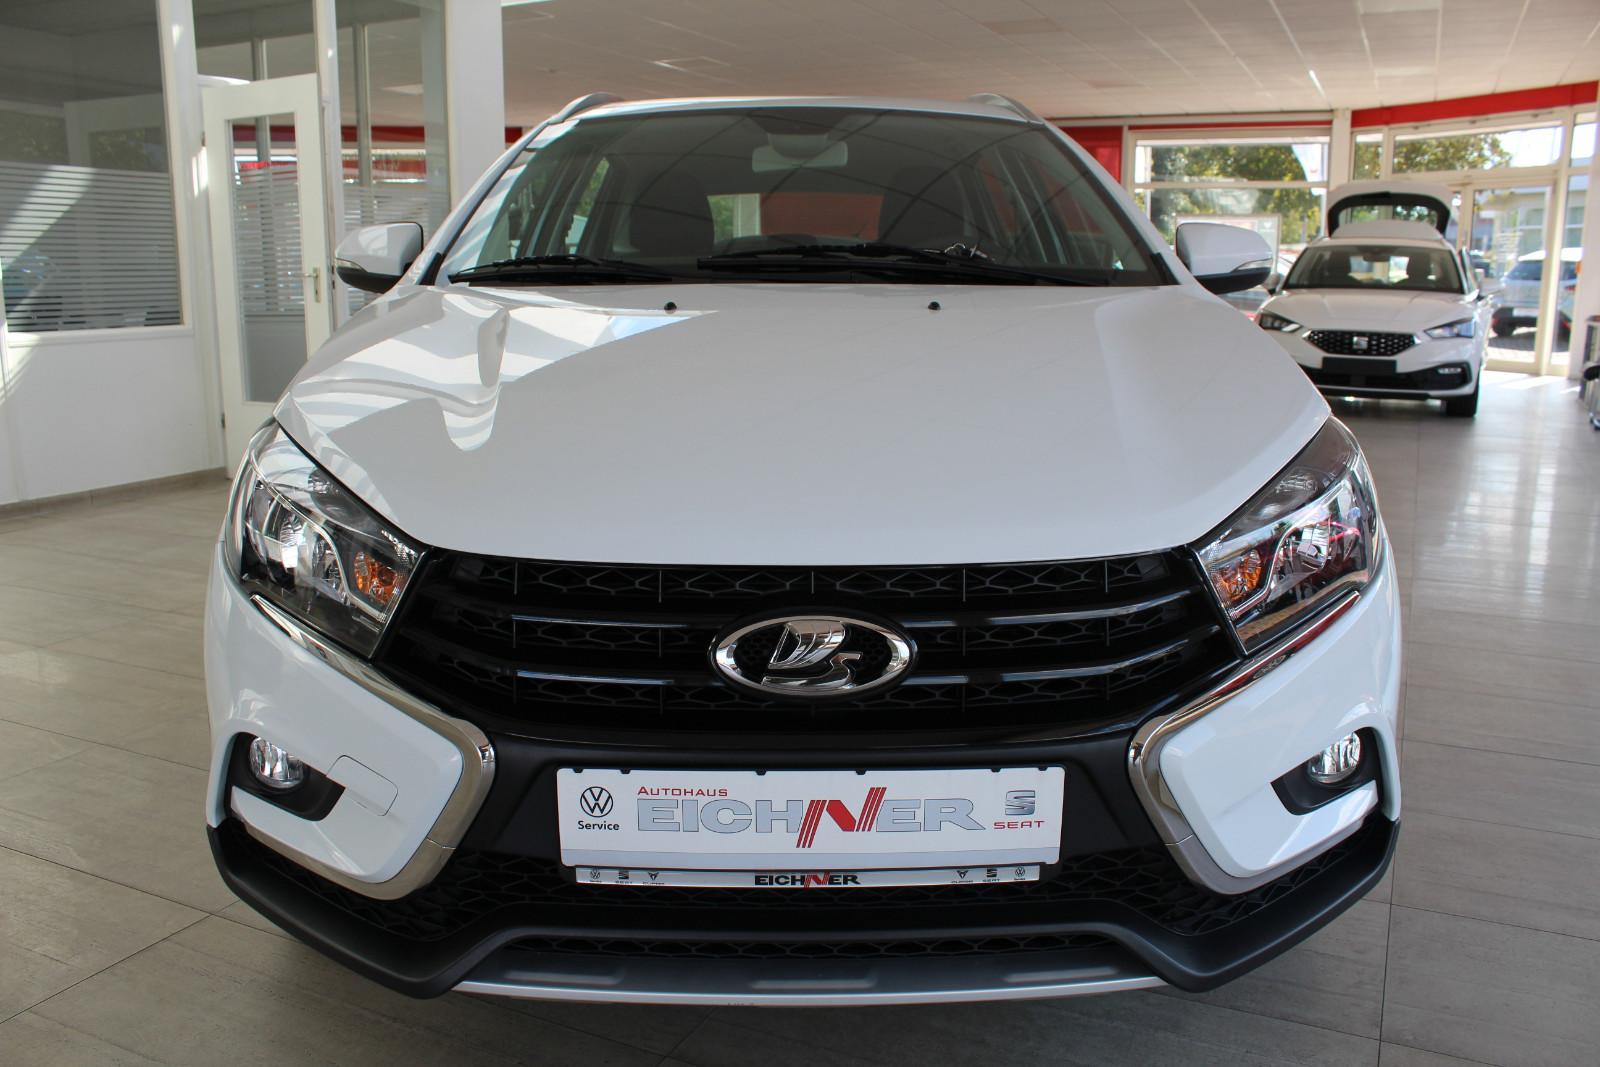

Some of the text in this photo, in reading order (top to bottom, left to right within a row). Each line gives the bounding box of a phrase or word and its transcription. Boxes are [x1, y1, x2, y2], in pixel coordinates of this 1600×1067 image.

[637, 787, 986, 848] EICHNER
[578, 820, 620, 831] Service
[993, 820, 1045, 829] SEAT
[754, 872, 861, 887] EICHNER
